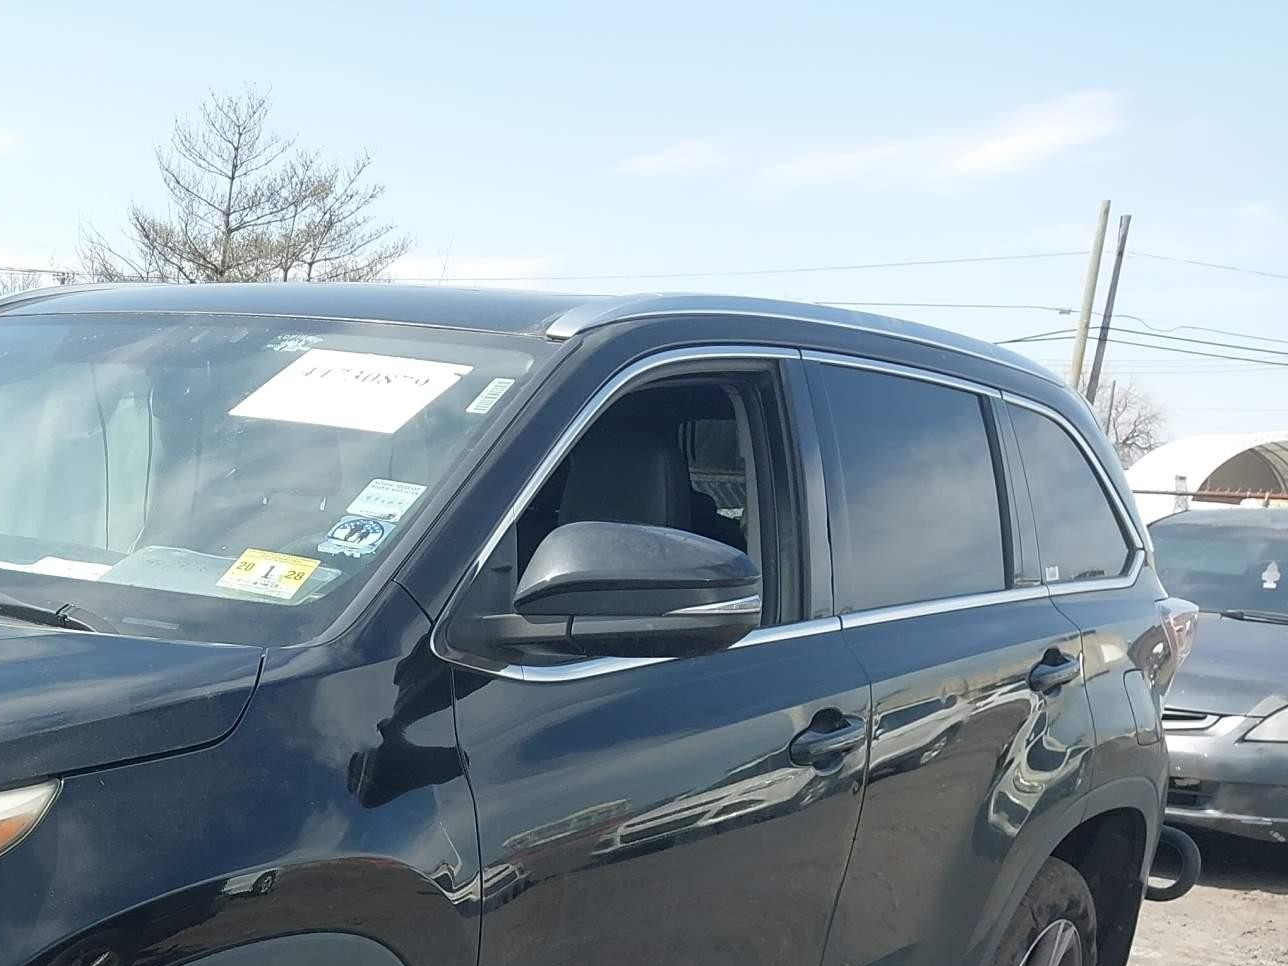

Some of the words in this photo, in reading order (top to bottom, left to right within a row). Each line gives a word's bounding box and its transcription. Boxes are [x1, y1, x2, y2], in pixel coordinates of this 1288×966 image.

[236, 561, 256, 571] 20
[260, 565, 275, 579] 1
[283, 570, 305, 581] 28
